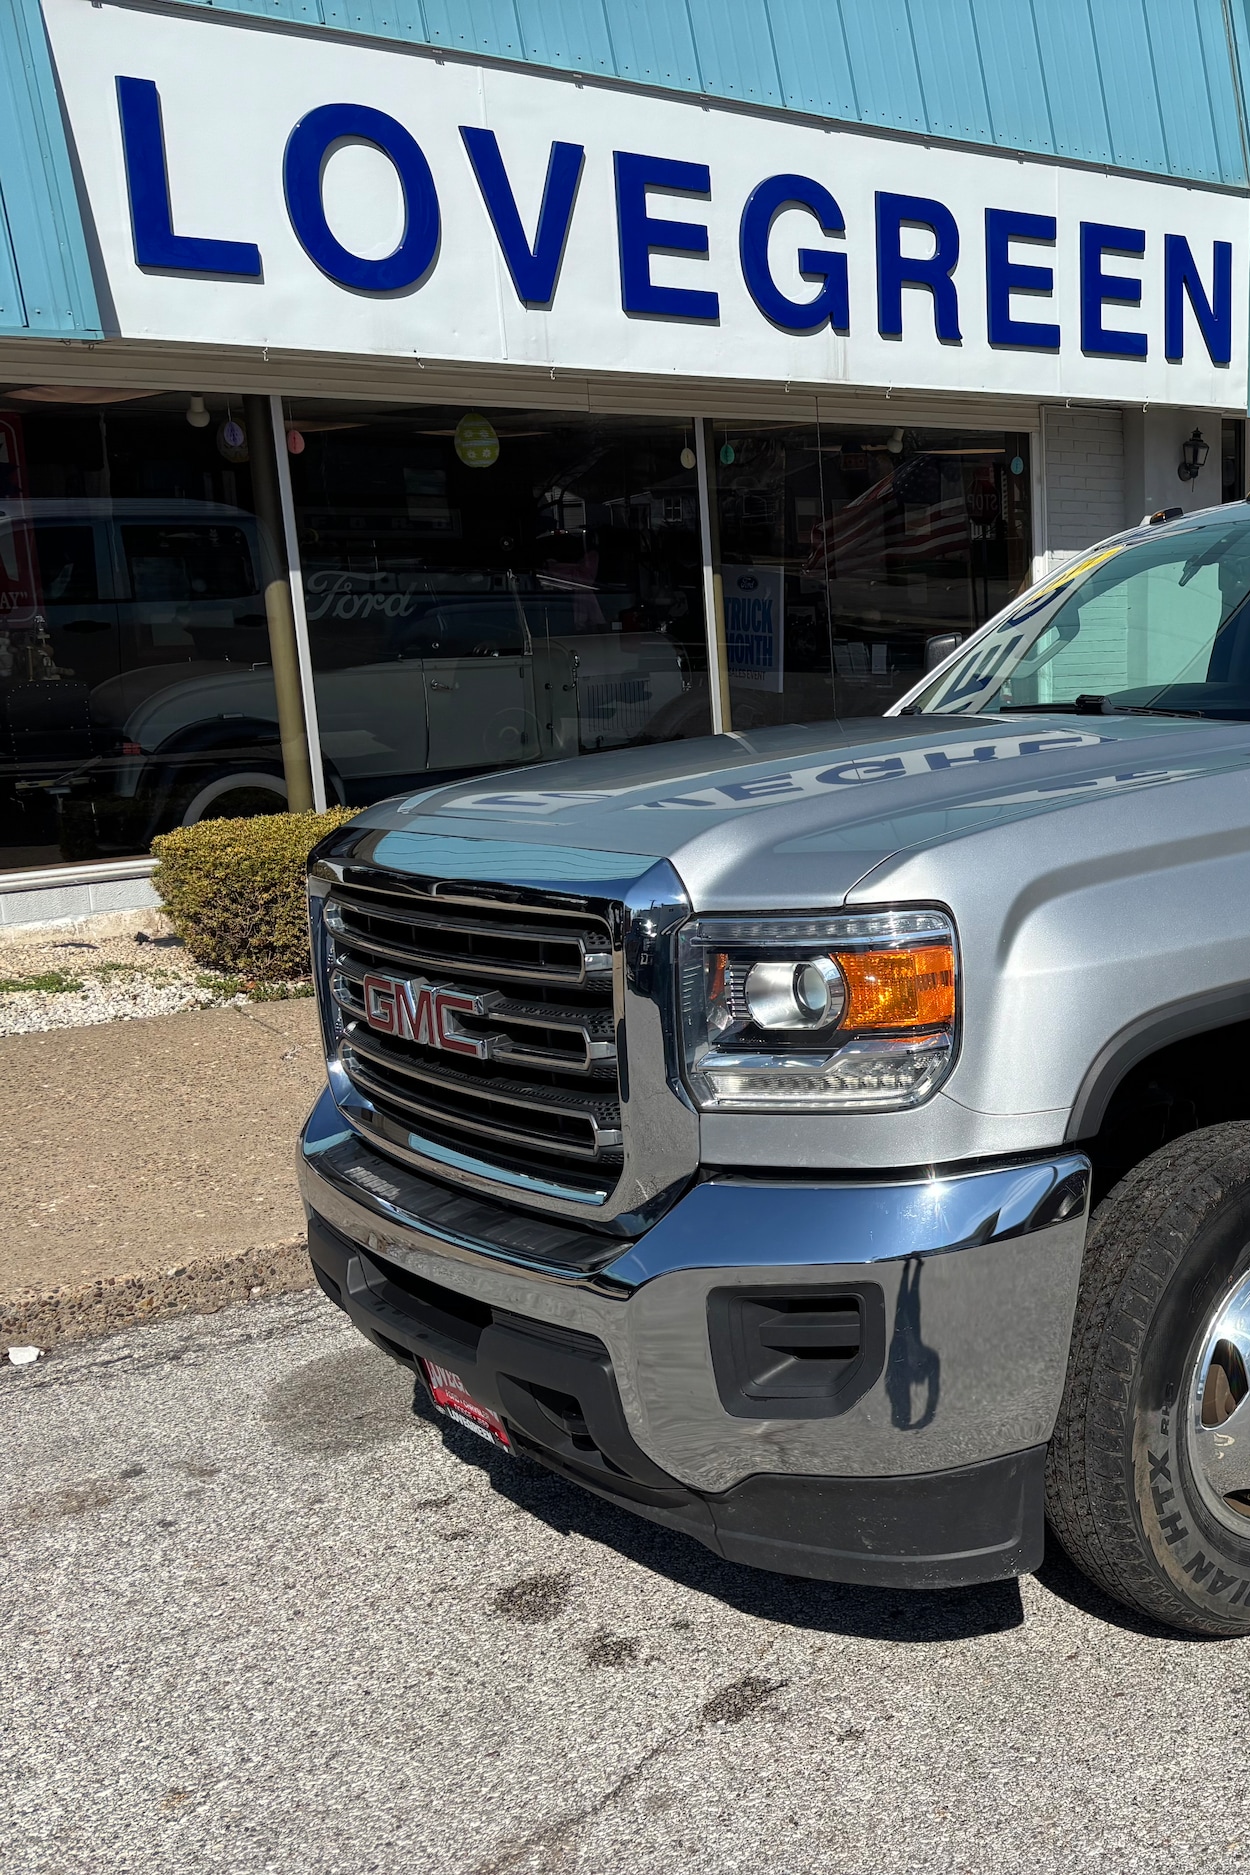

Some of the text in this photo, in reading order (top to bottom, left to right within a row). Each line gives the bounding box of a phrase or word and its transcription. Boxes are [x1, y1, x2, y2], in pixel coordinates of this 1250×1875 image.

[114, 75, 1233, 365] LOVEGREEN
[306, 570, 419, 621] Ford
[724, 597, 773, 634] TRUCK
[747, 669, 765, 681] EVENT
[364, 973, 490, 1060] GMC
[1147, 1449, 1190, 1546] HTX
